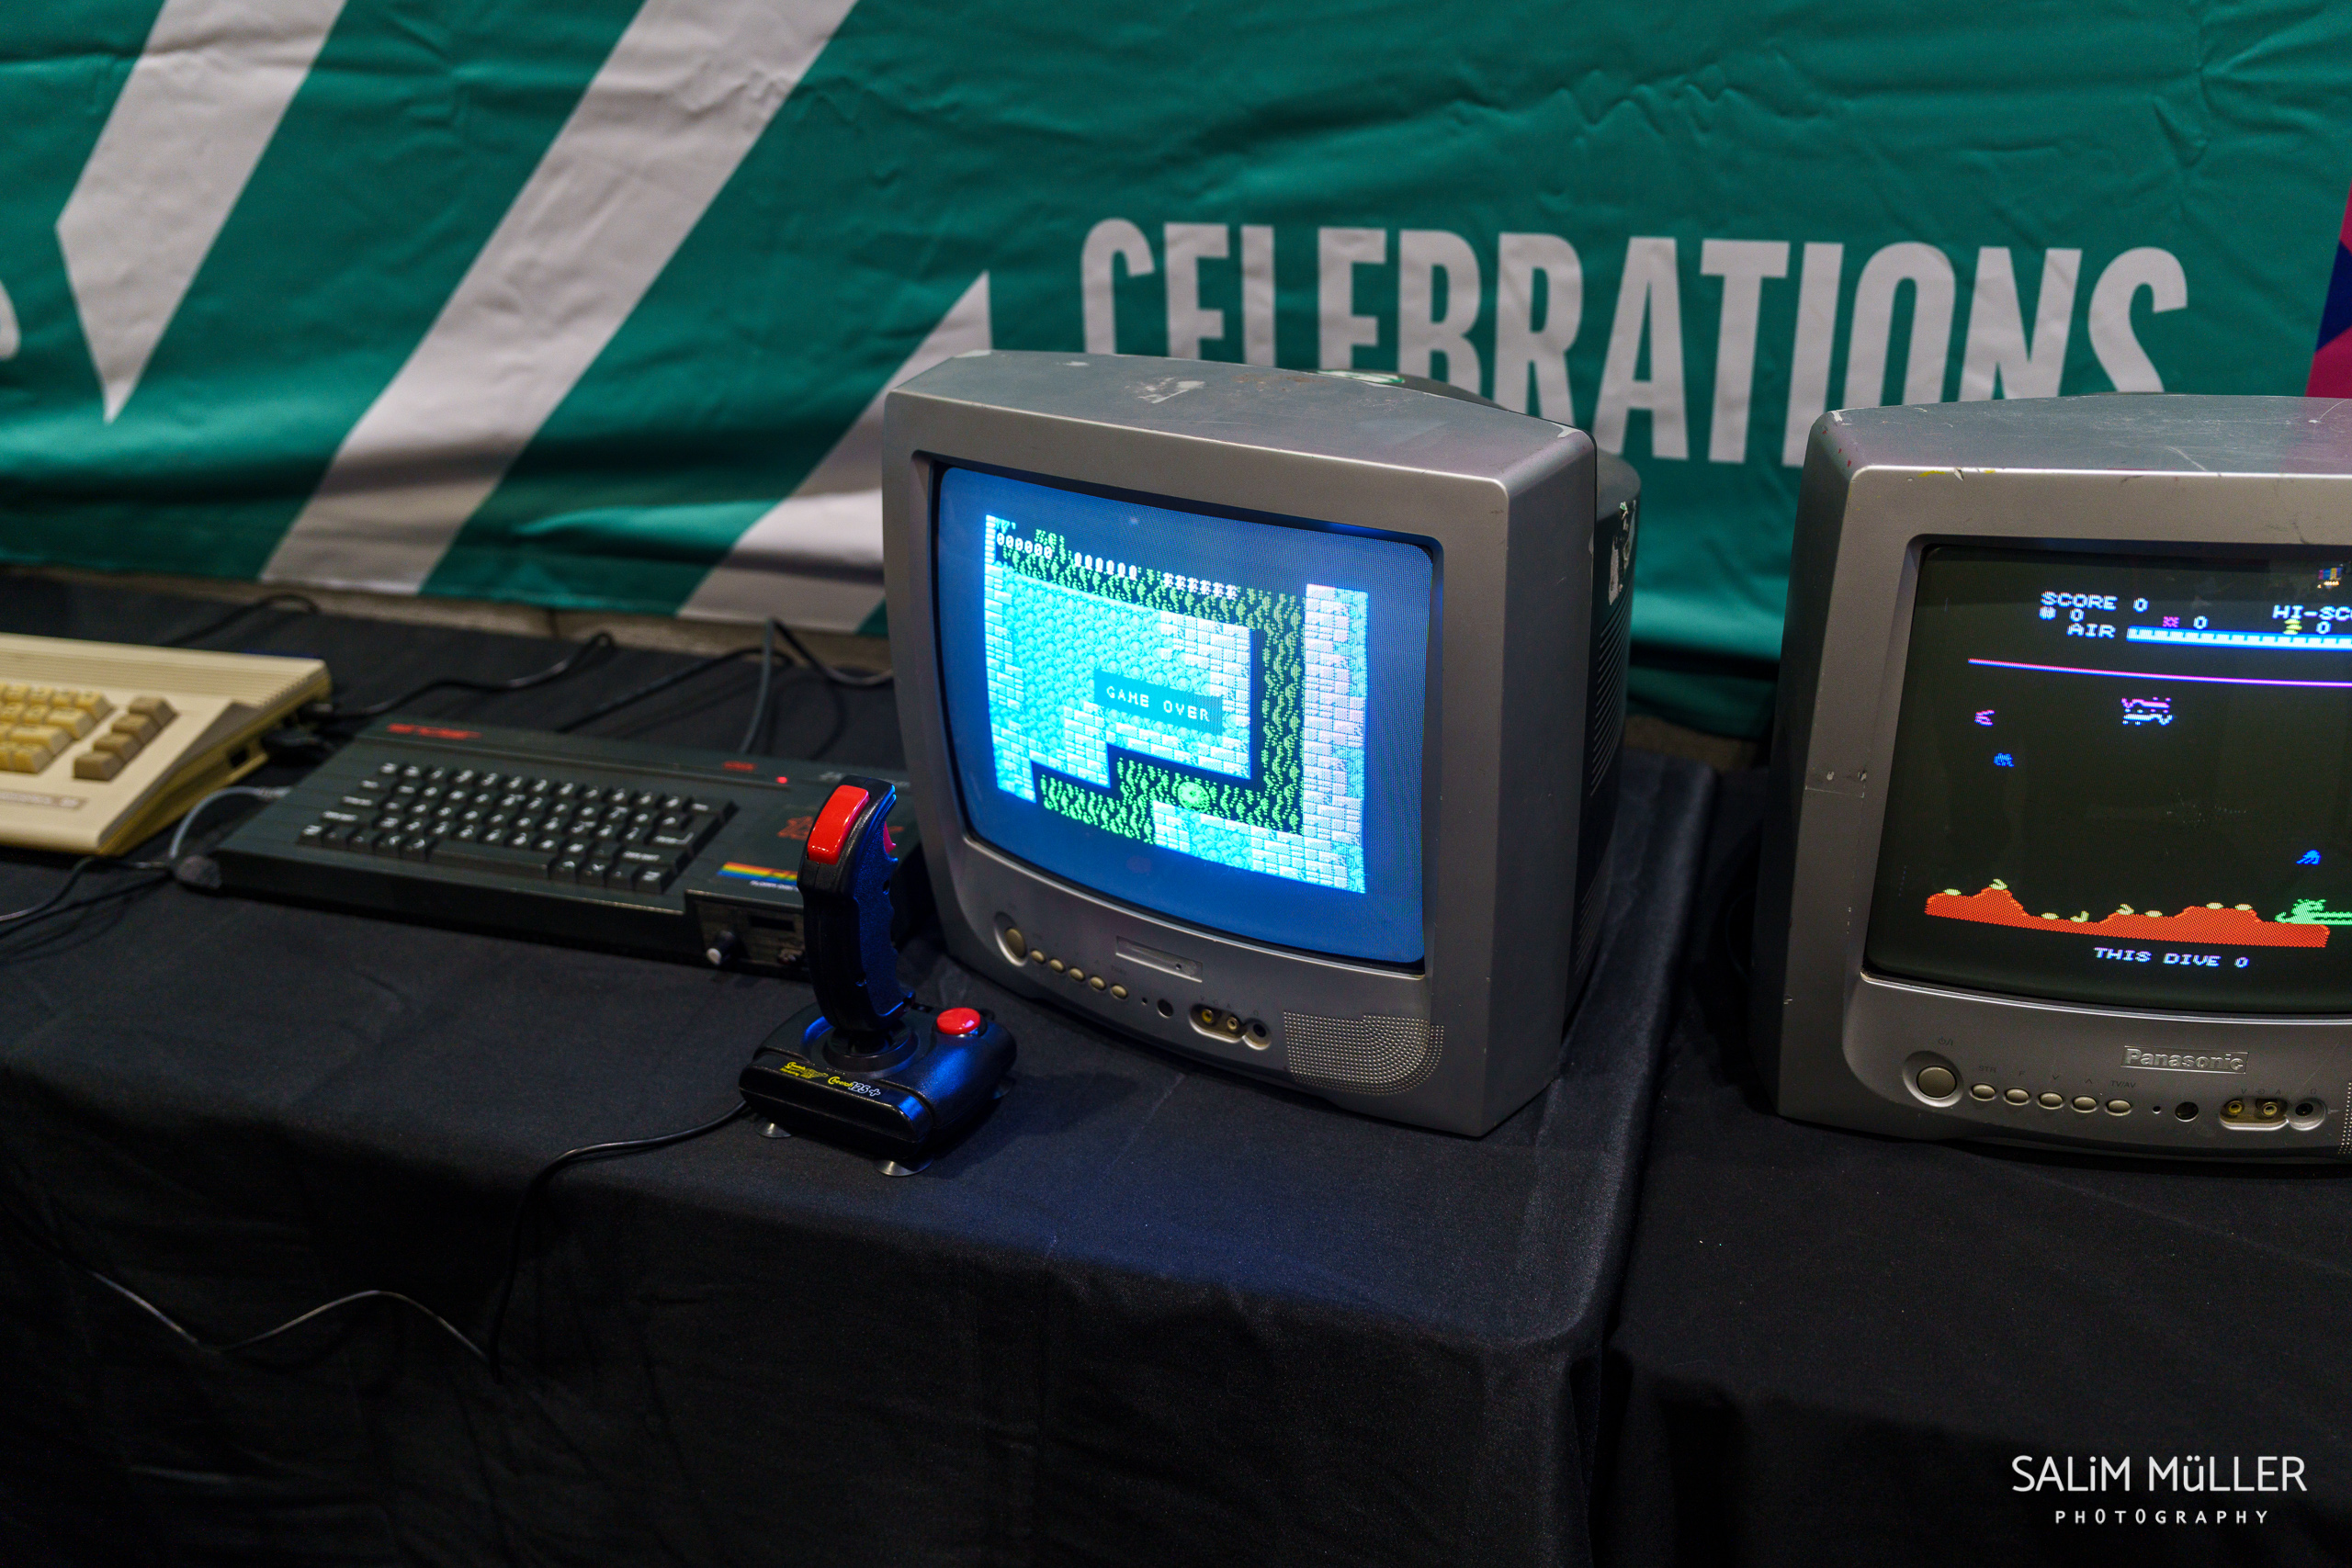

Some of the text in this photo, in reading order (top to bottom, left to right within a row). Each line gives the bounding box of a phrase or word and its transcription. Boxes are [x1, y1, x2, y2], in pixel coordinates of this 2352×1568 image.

[1081, 218, 2188, 467] CELEBRATIONS
[2040, 591, 2119, 611] SCORE
[2067, 623, 2117, 638] AIR
[1105, 685, 1210, 722] GAME OVER
[2094, 947, 2152, 964] THIS
[2163, 953, 2222, 967] DIVE
[2125, 1048, 2244, 1071] Panasonic
